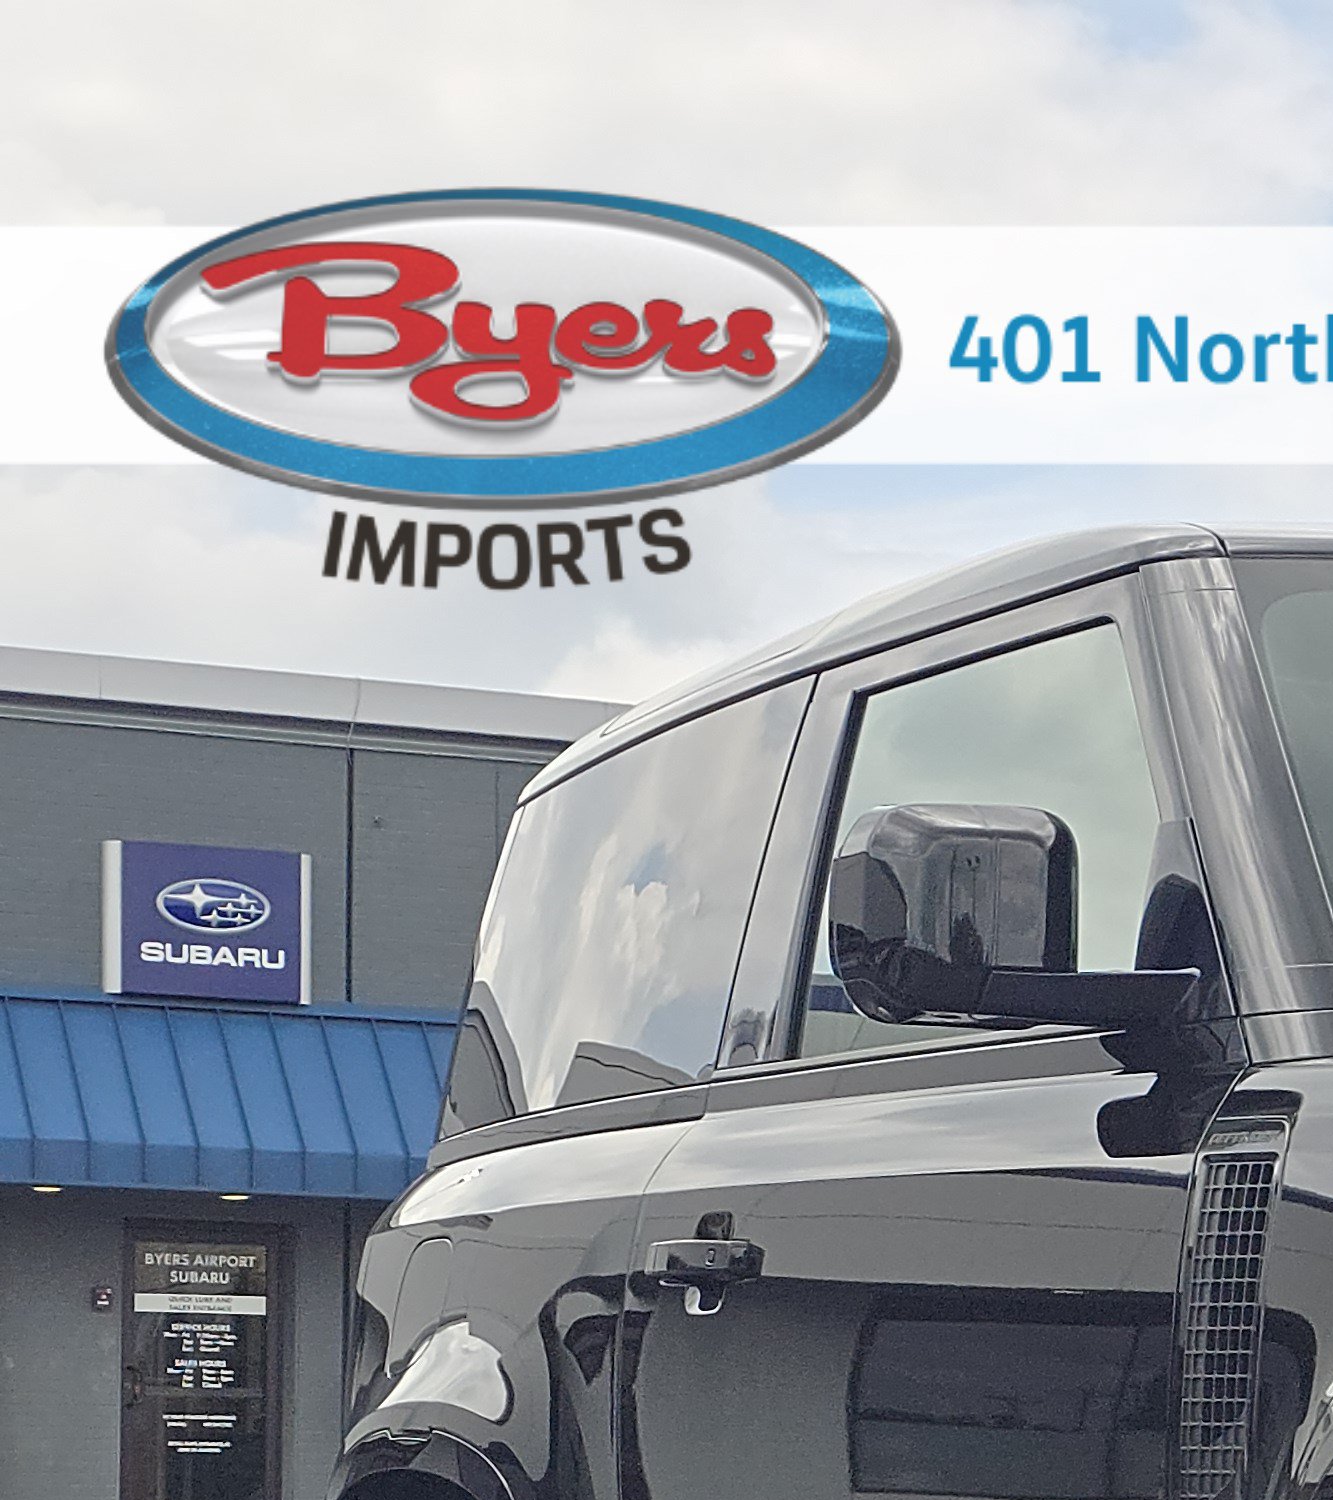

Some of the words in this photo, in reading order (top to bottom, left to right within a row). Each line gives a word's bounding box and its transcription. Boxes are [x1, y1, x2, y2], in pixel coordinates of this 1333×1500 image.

[140, 941, 286, 970] SUBARU
[144, 1252, 190, 1266] BYERS
[193, 1254, 257, 1268] AIRPORT
[169, 1270, 230, 1285] SUBARU
